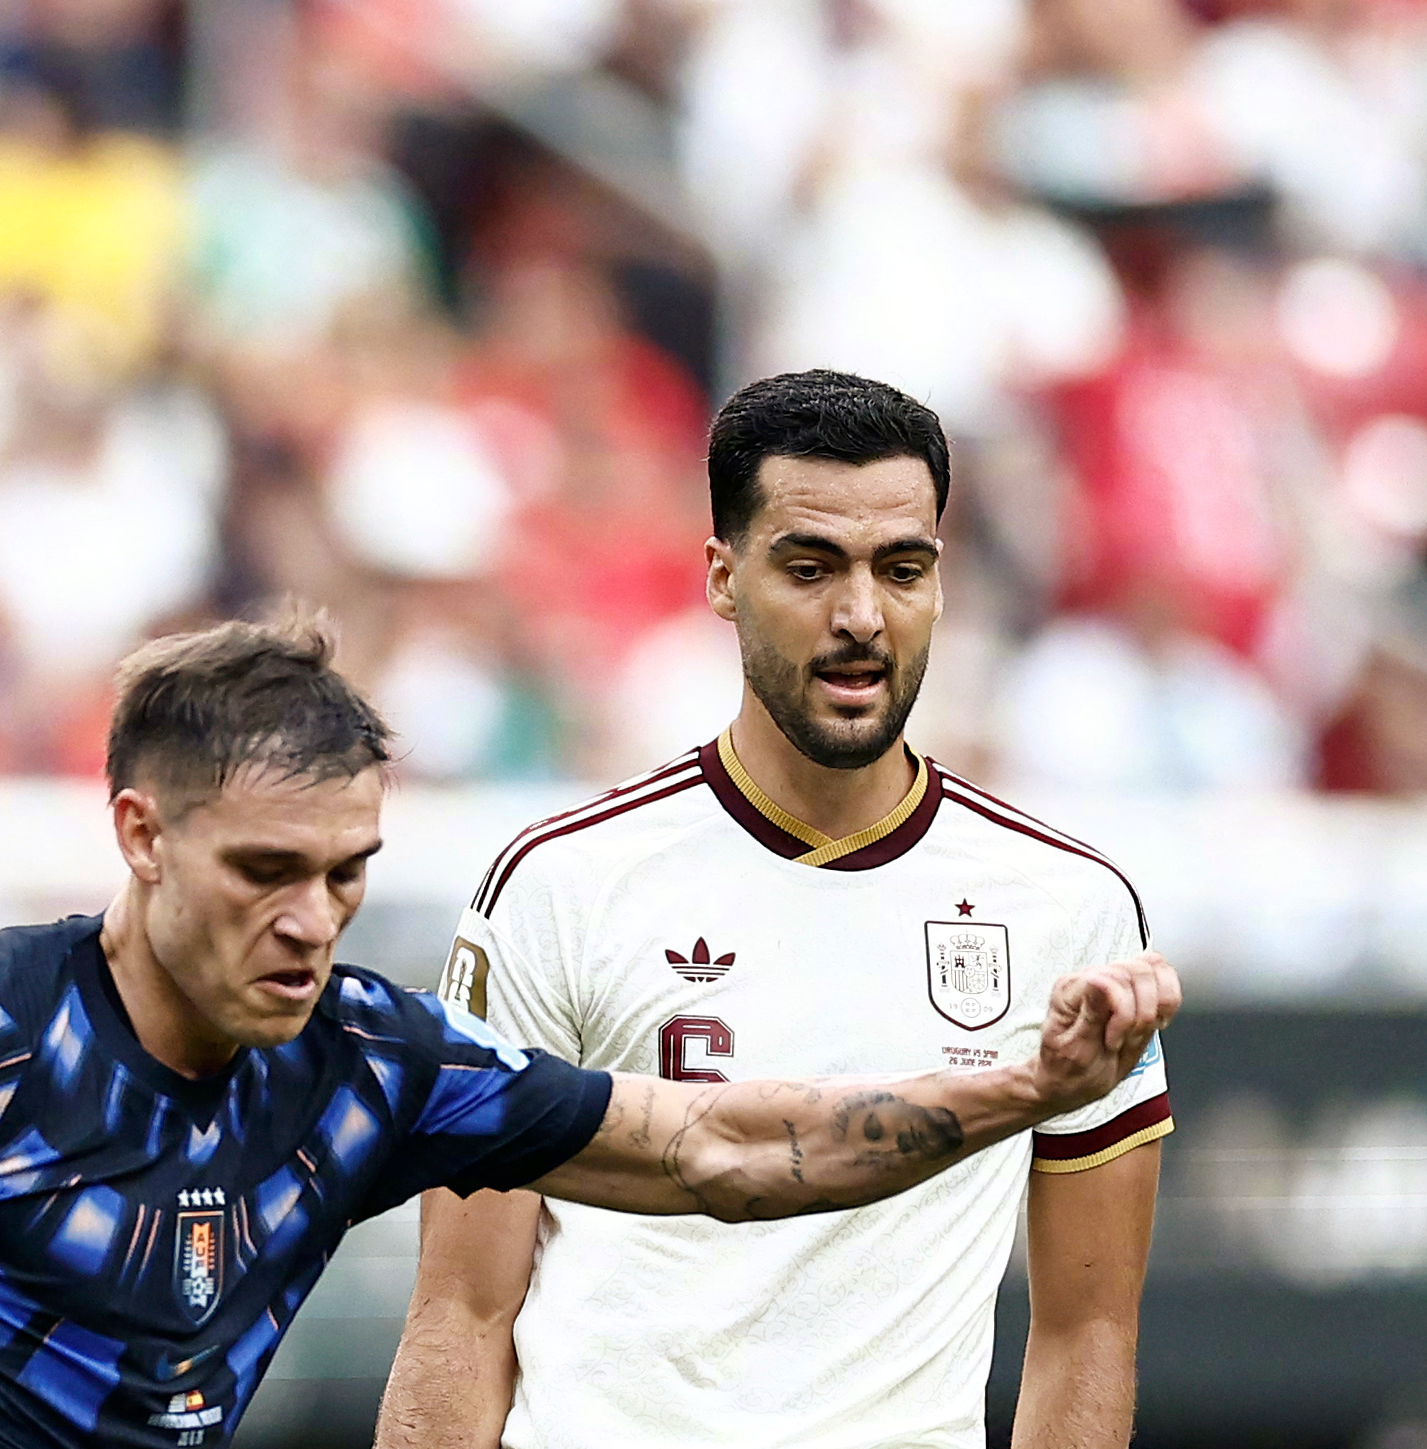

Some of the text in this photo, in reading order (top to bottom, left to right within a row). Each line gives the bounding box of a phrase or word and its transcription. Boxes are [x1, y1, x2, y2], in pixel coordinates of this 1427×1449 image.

[941, 1046, 971, 1057] URUGUAY
[973, 1048, 981, 1058] VS
[948, 1056, 958, 1066] 26
[960, 1057, 976, 1067] JUNE
